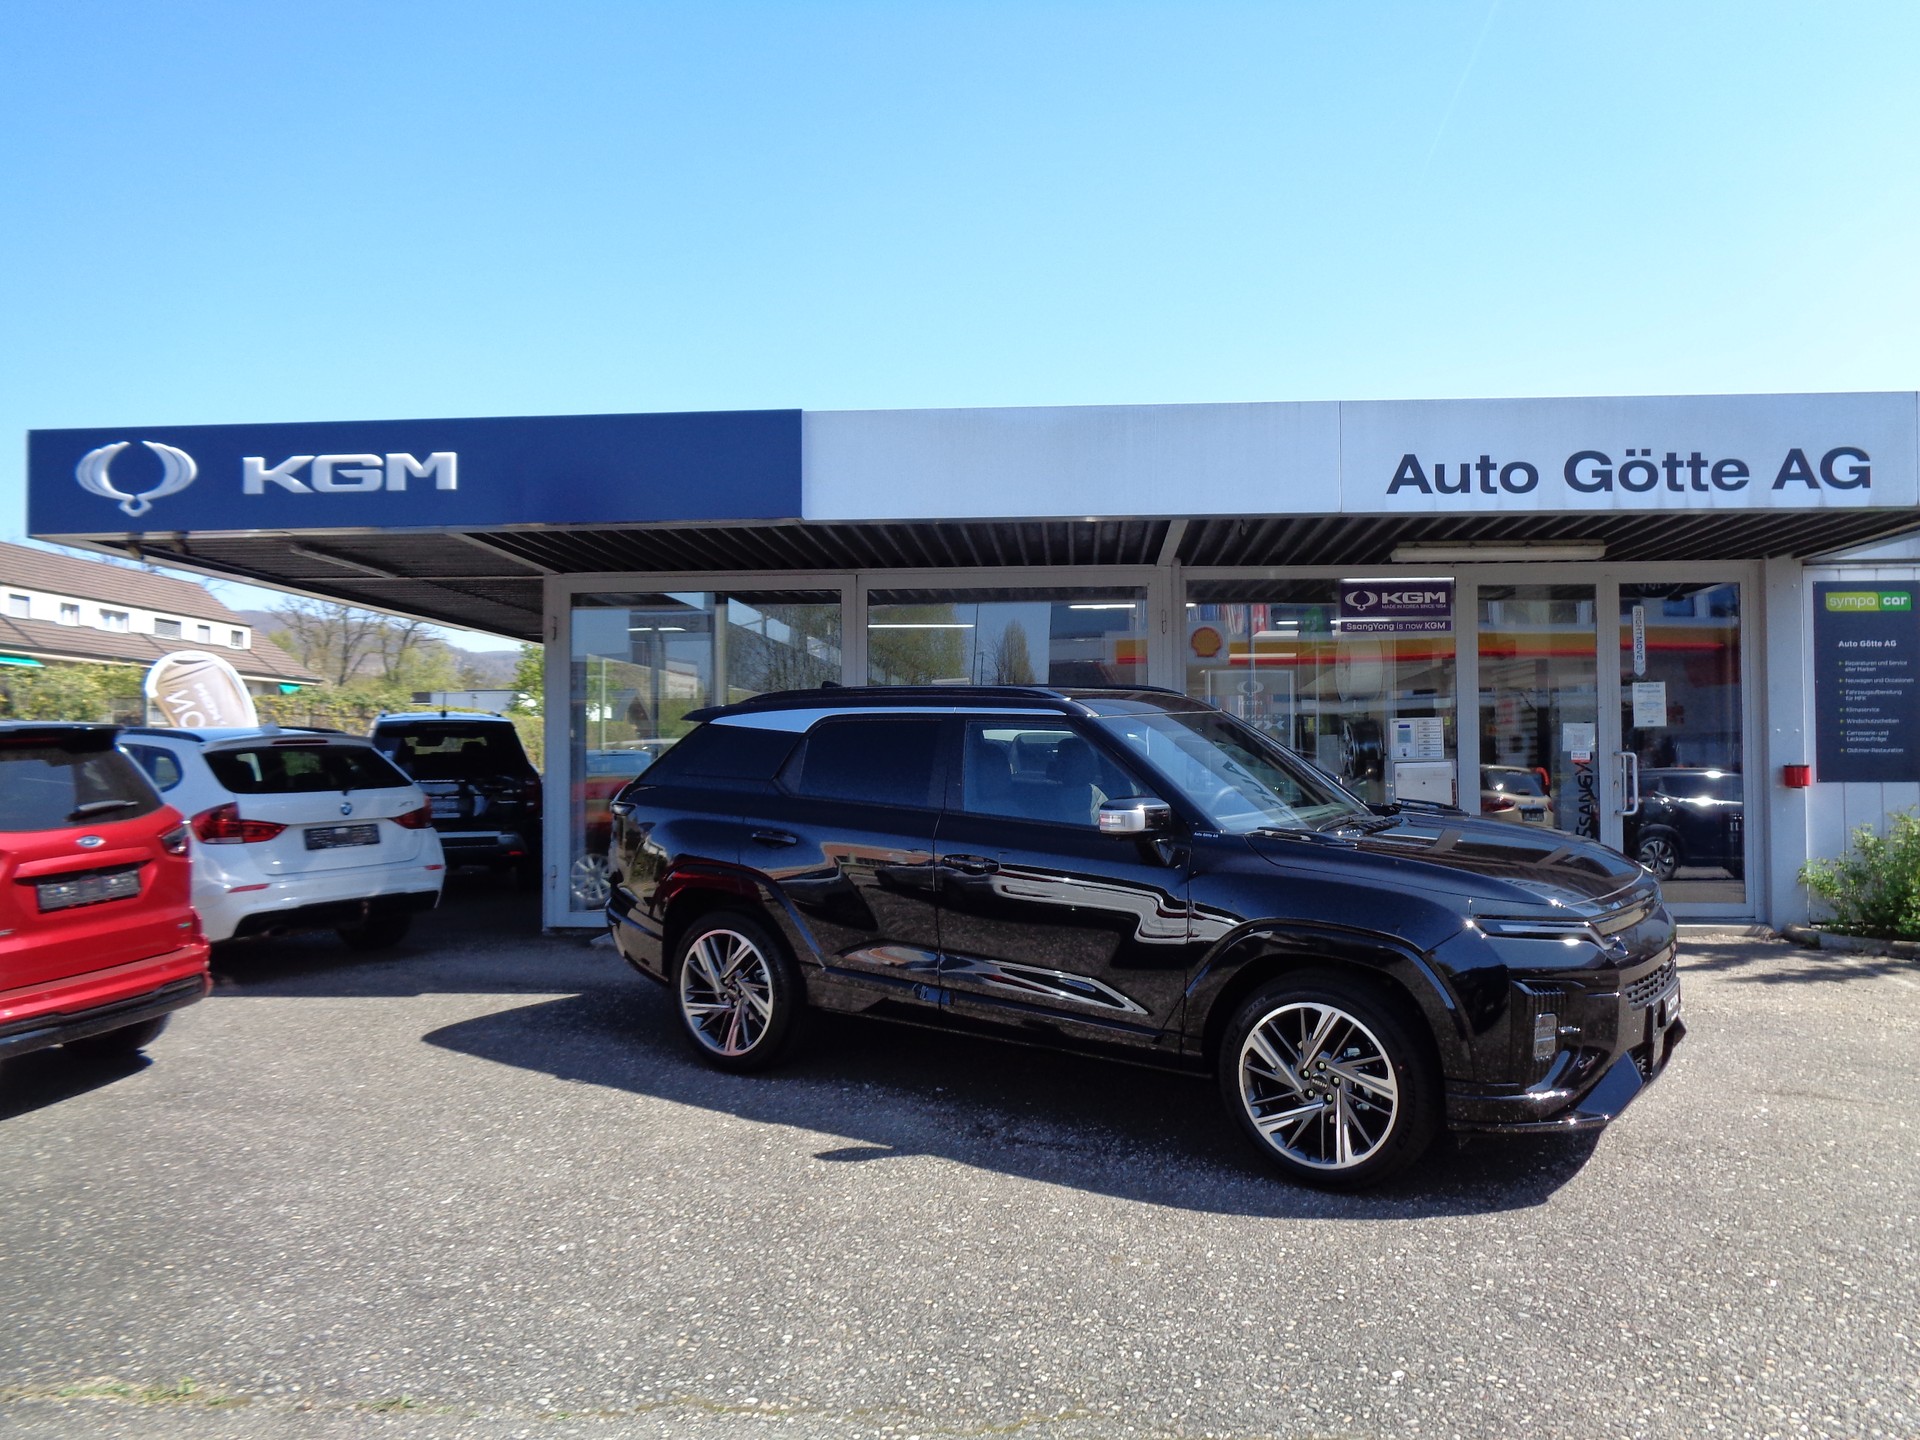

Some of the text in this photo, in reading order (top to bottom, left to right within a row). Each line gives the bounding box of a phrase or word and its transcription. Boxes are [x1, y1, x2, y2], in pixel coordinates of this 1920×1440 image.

[242, 451, 458, 494] KGM
[1386, 446, 1872, 494] Auto Götte AG
[1381, 591, 1446, 604] KGM
[1883, 596, 1908, 606] car
[1346, 622, 1395, 631] SsangYong
[1396, 622, 1404, 630] is
[1424, 621, 1446, 630] KGM
[1860, 639, 1883, 648] Götte
[1884, 639, 1897, 647] AG
